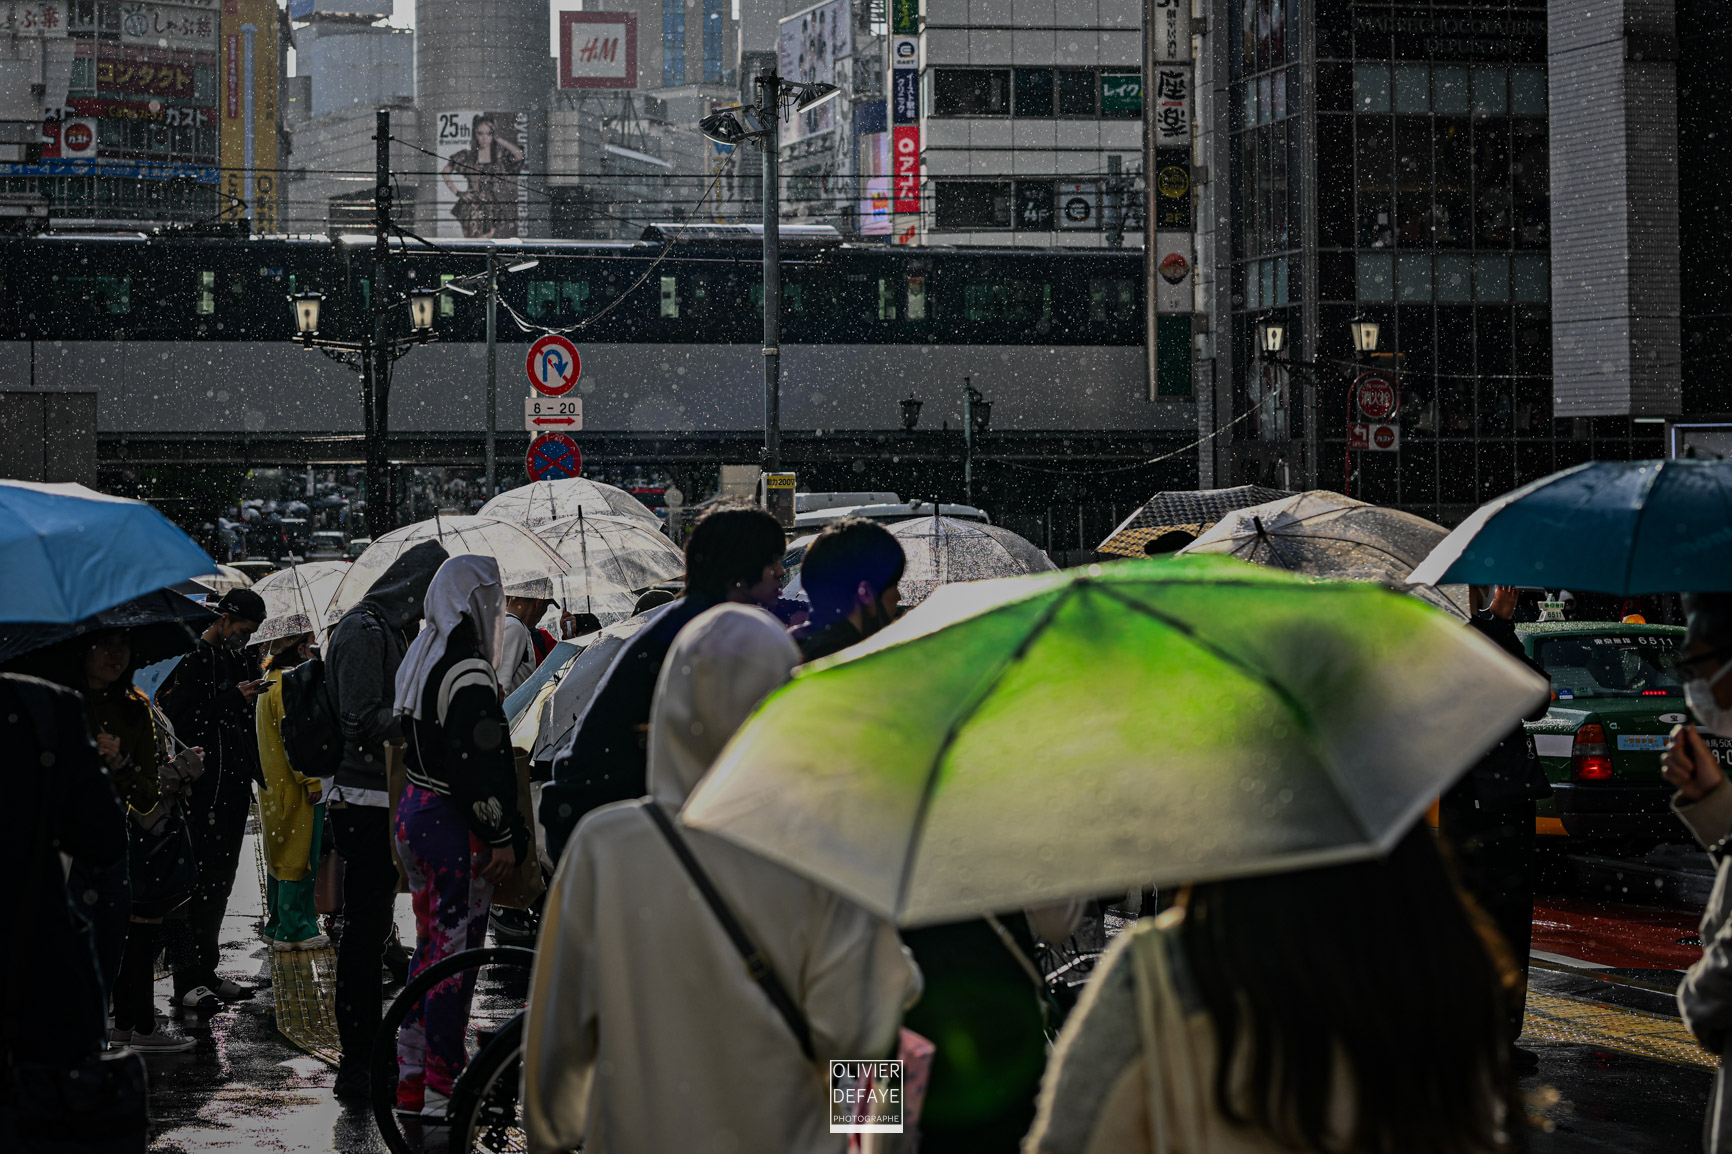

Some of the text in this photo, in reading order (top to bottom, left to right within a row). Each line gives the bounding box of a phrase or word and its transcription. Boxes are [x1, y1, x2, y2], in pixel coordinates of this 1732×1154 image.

[153, 13, 211, 37] しゃぶ葉
[1418, 16, 1536, 35] CHOCOLATIER
[580, 37, 619, 63] H&M
[97, 63, 191, 90] コンタクト
[1103, 84, 1139, 97] レイク
[165, 106, 208, 128] ガスト
[440, 114, 471, 138] 25th
[68, 134, 89, 144] ガスト
[899, 156, 915, 201] アコム
[1165, 213, 1183, 223] 2F
[534, 403, 541, 414] 6
[560, 403, 575, 414] 20
[1638, 636, 1674, 646] 6511
